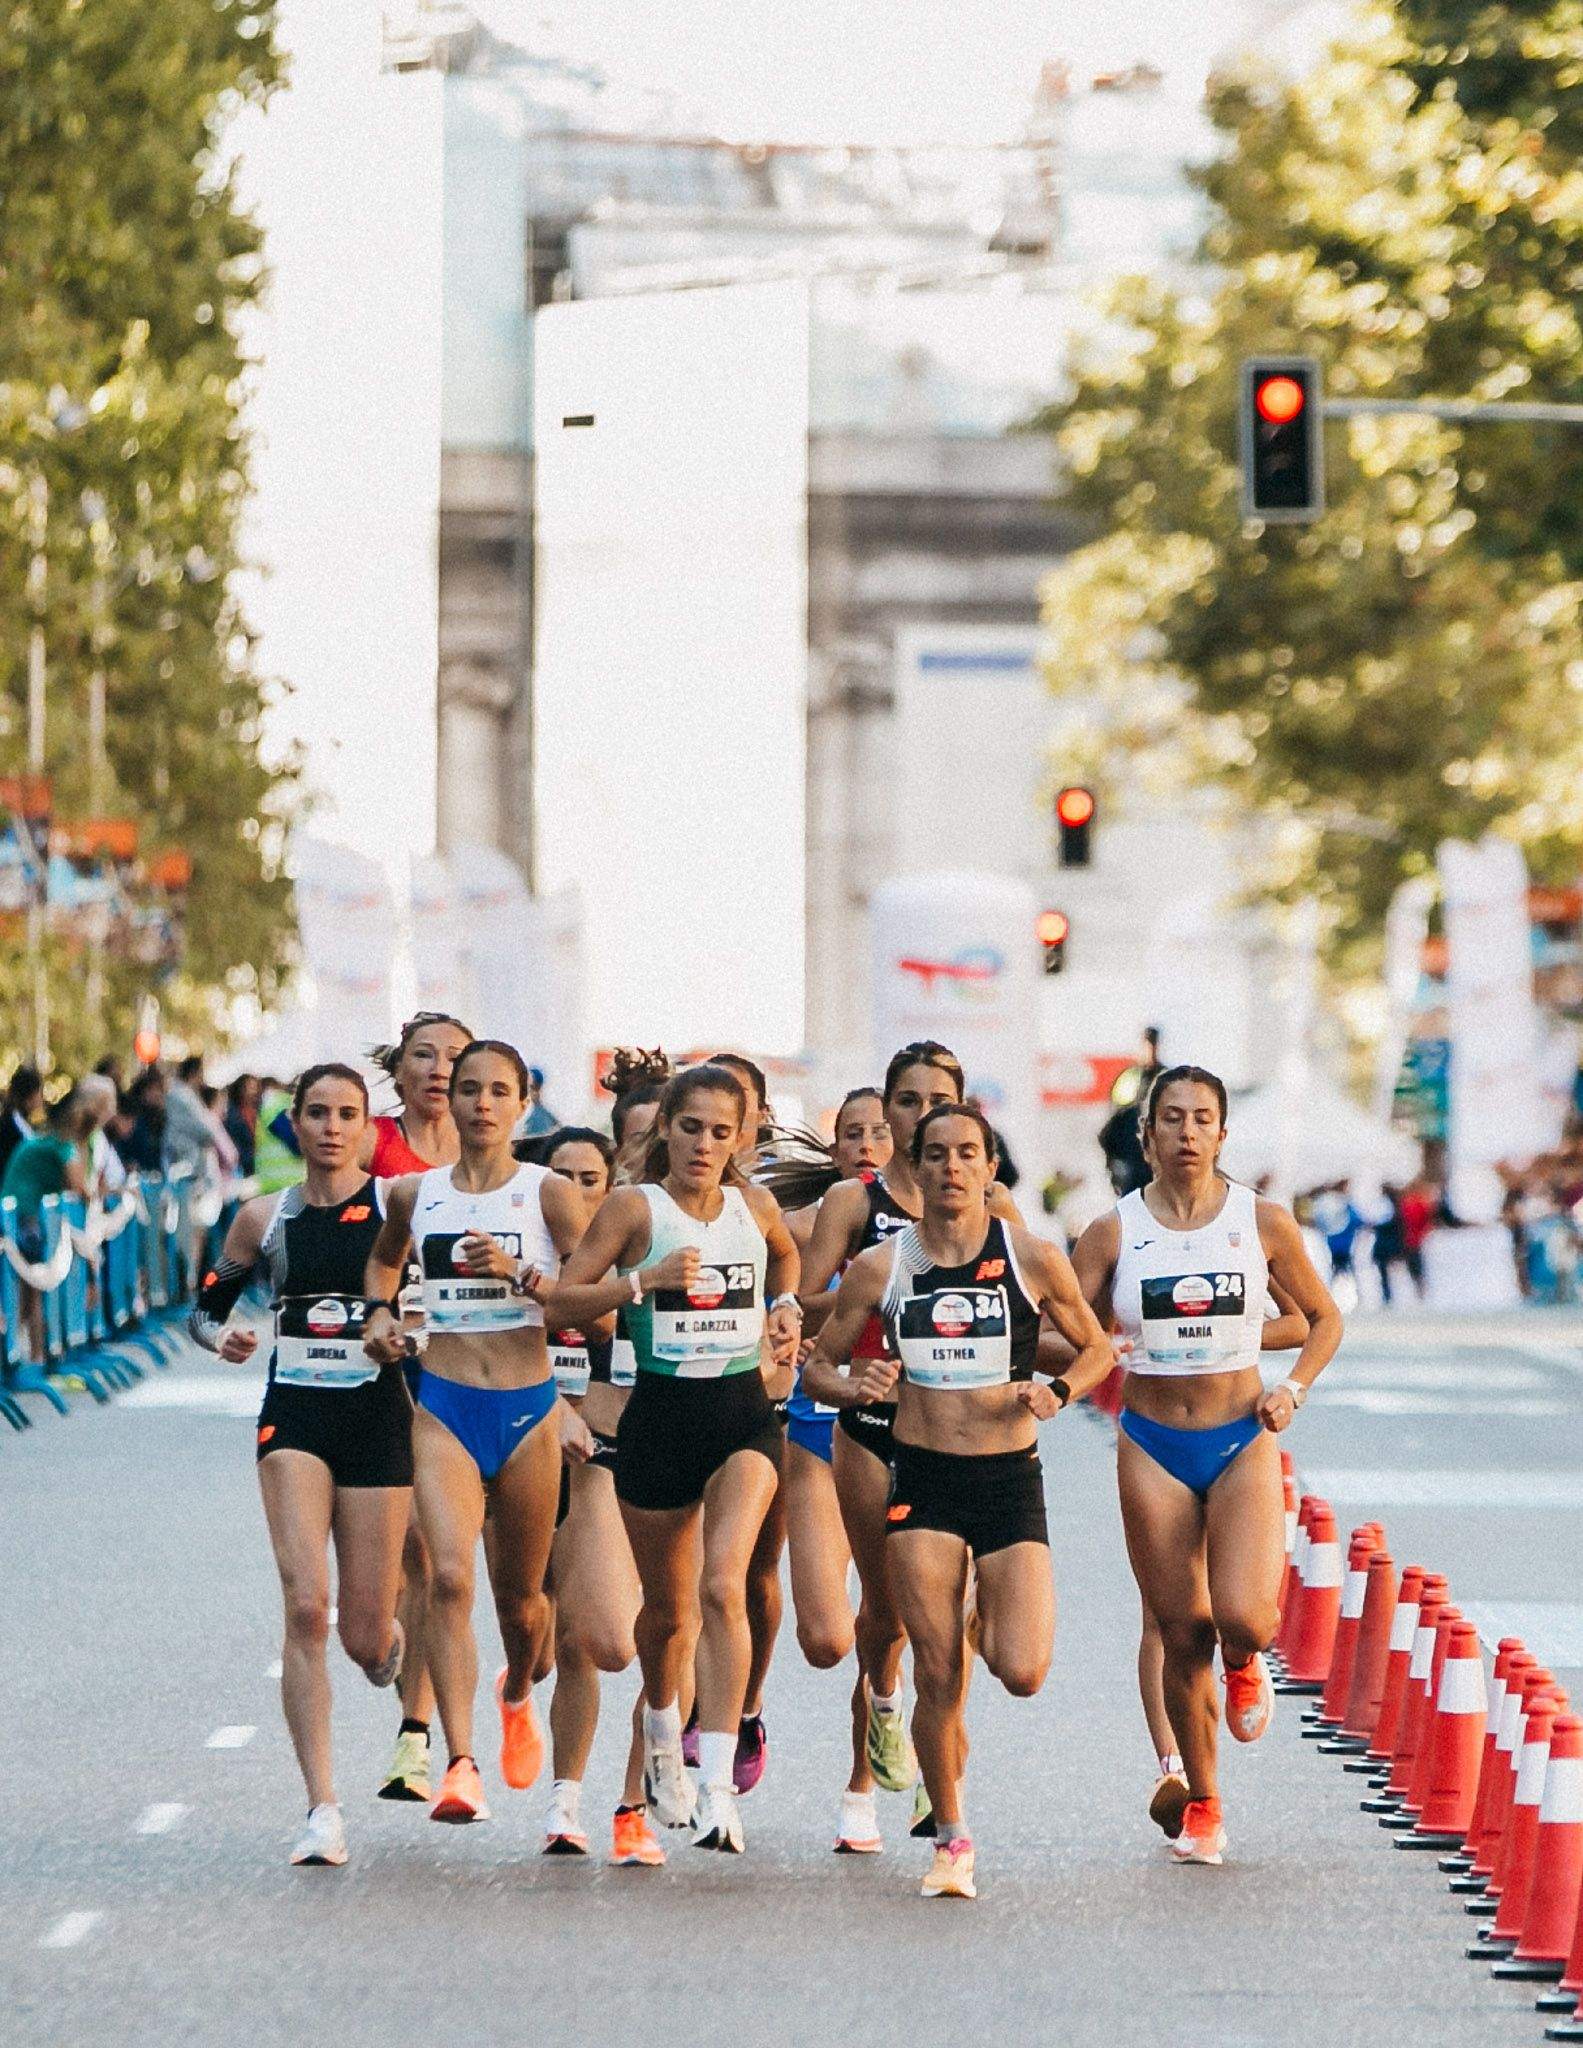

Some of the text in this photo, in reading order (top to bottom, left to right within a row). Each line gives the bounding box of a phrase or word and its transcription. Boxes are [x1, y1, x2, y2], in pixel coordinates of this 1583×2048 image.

[727, 1265, 753, 1290] 25
[1215, 1274, 1243, 1297] 24
[976, 1295, 1003, 1318] 34
[693, 1319, 738, 1333] GARZZIA
[1177, 1325, 1213, 1339] MARÍA
[932, 1348, 976, 1360] ESTHER
